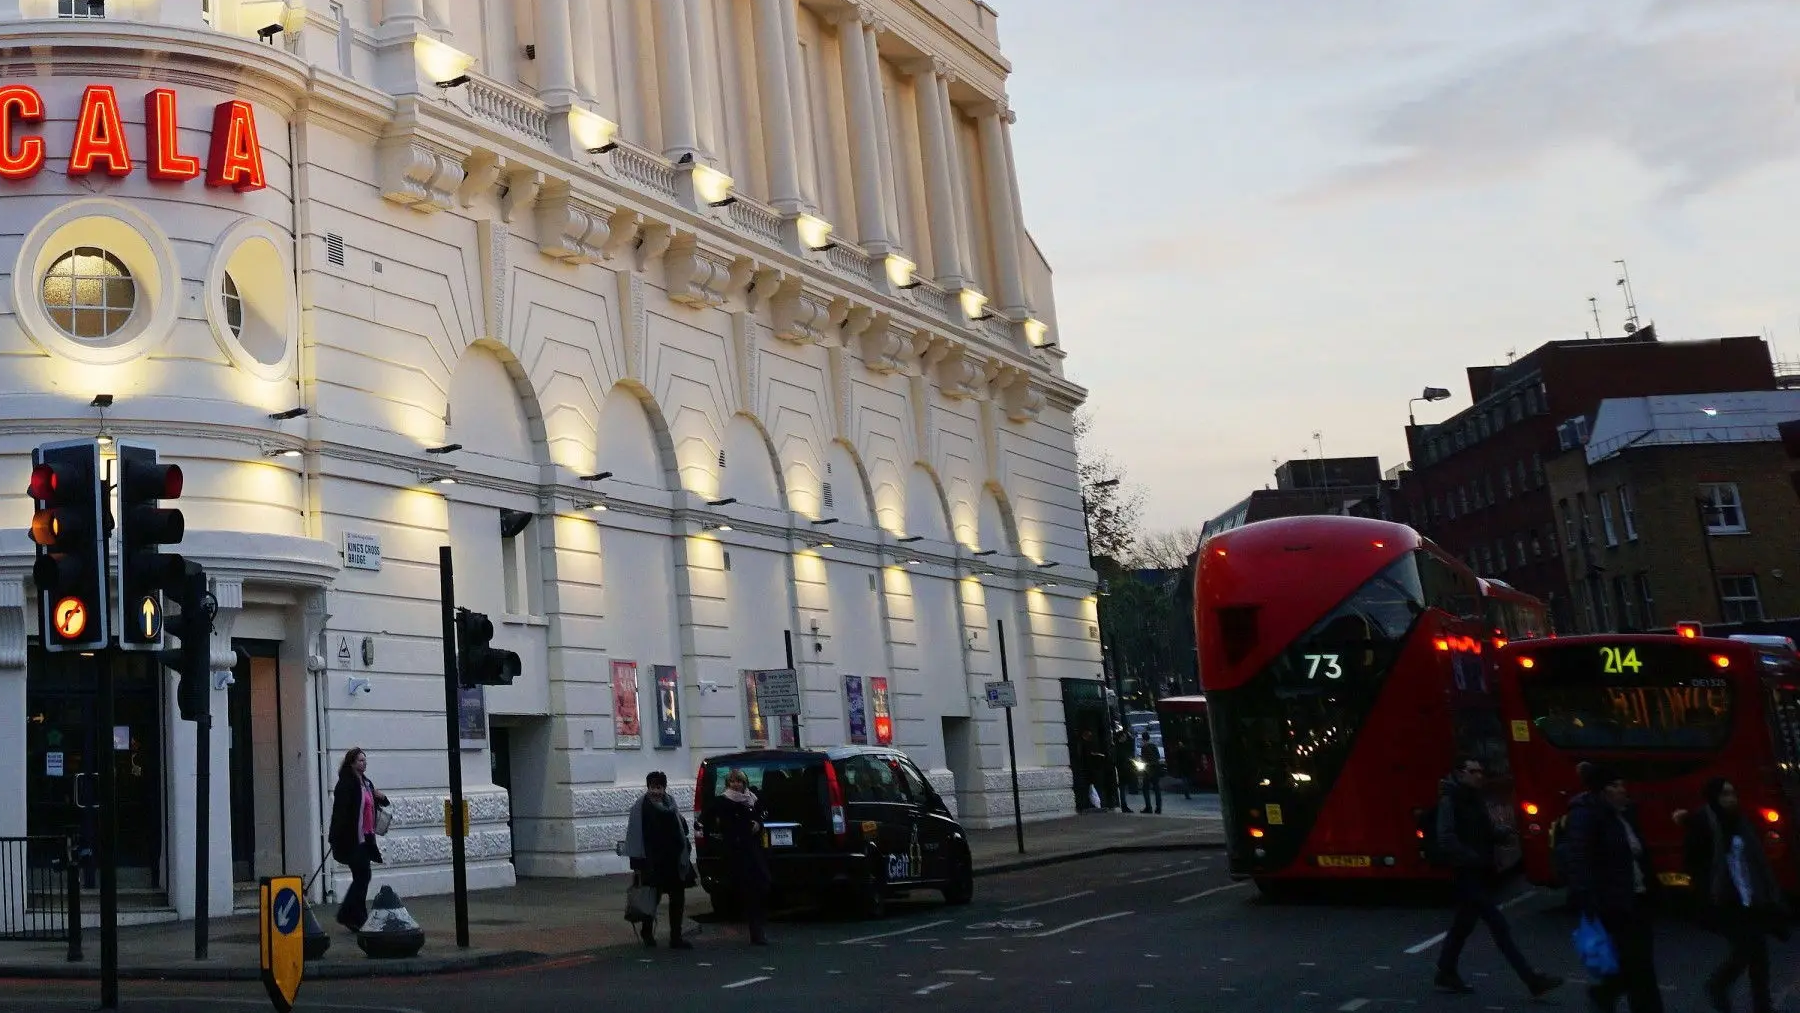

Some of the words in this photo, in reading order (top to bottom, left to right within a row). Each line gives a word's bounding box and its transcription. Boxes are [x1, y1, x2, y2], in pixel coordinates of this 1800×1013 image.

[365, 544, 381, 555] CROSS
[348, 553, 366, 565] BRIDGE
[1304, 654, 1342, 679] 73
[1599, 646, 1643, 674] 214
